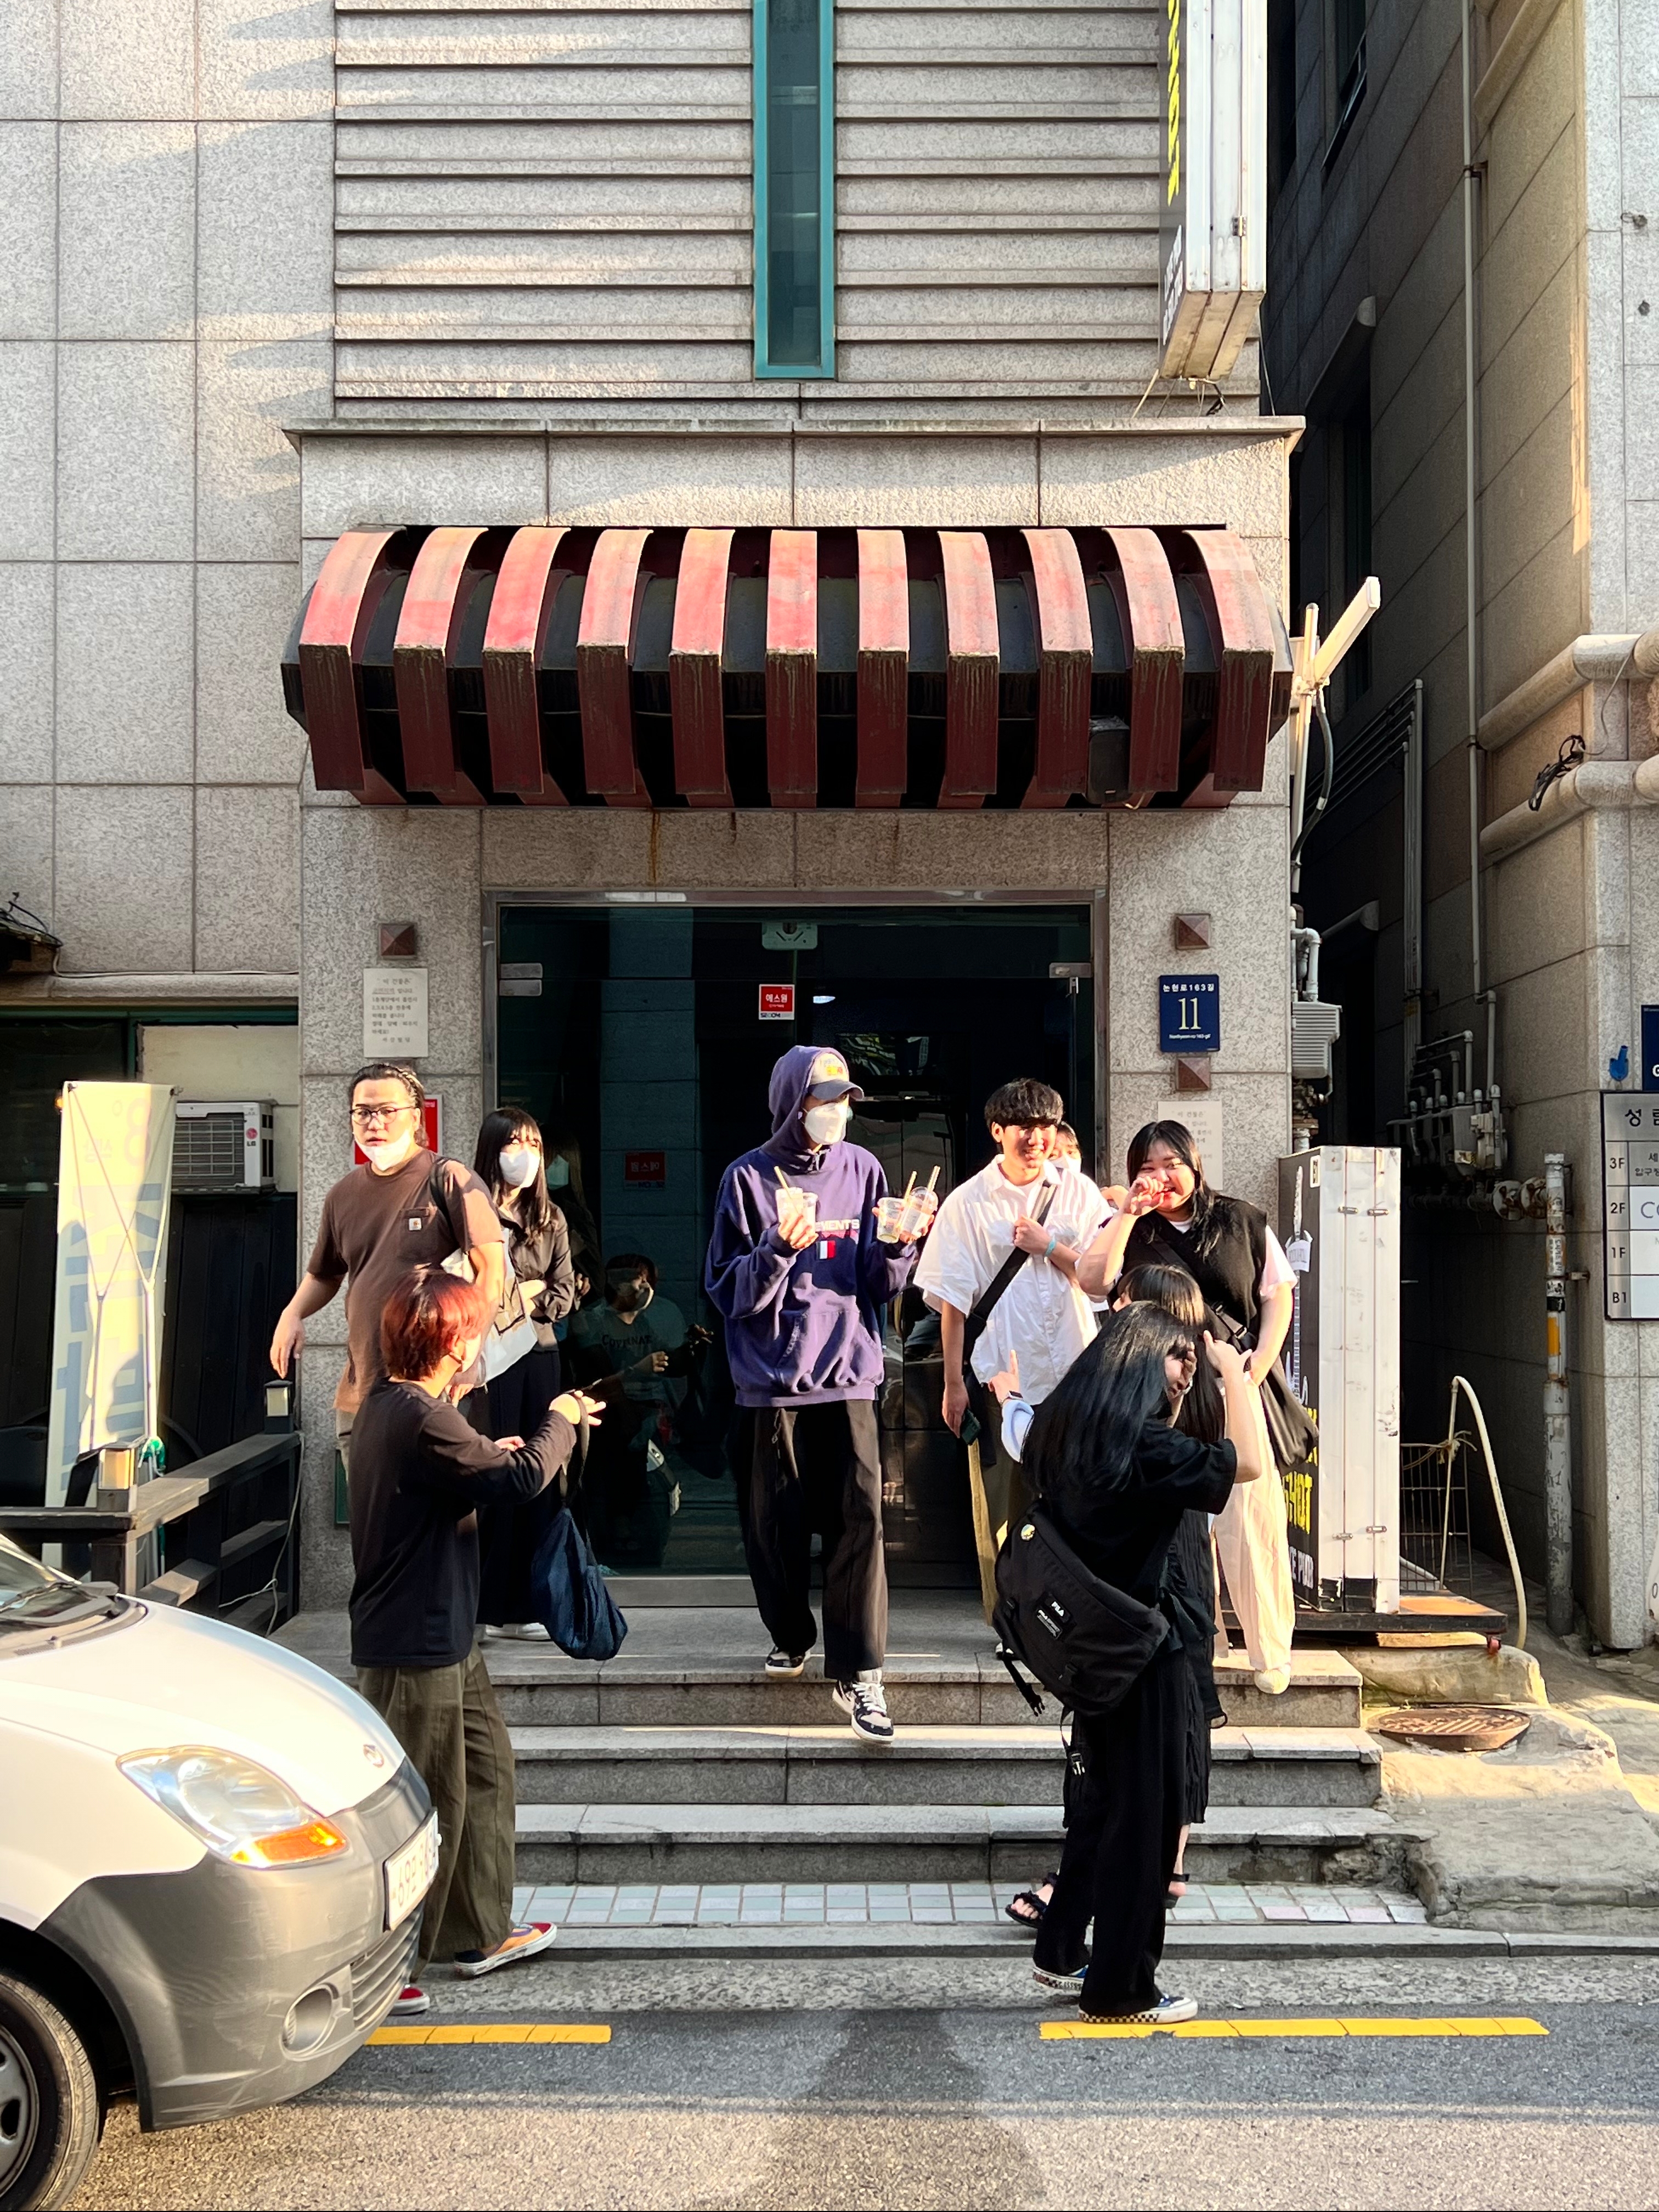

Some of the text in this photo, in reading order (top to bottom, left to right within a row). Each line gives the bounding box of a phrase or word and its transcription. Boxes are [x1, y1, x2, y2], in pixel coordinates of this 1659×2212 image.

[1178, 997, 1201, 1030] 11
[1609, 1158, 1626, 1169] 3F
[1610, 1202, 1626, 1214] 2F
[815, 1218, 860, 1232] EMENTS
[1611, 1247, 1626, 1259] 1F
[1612, 1291, 1627, 1304] B1
